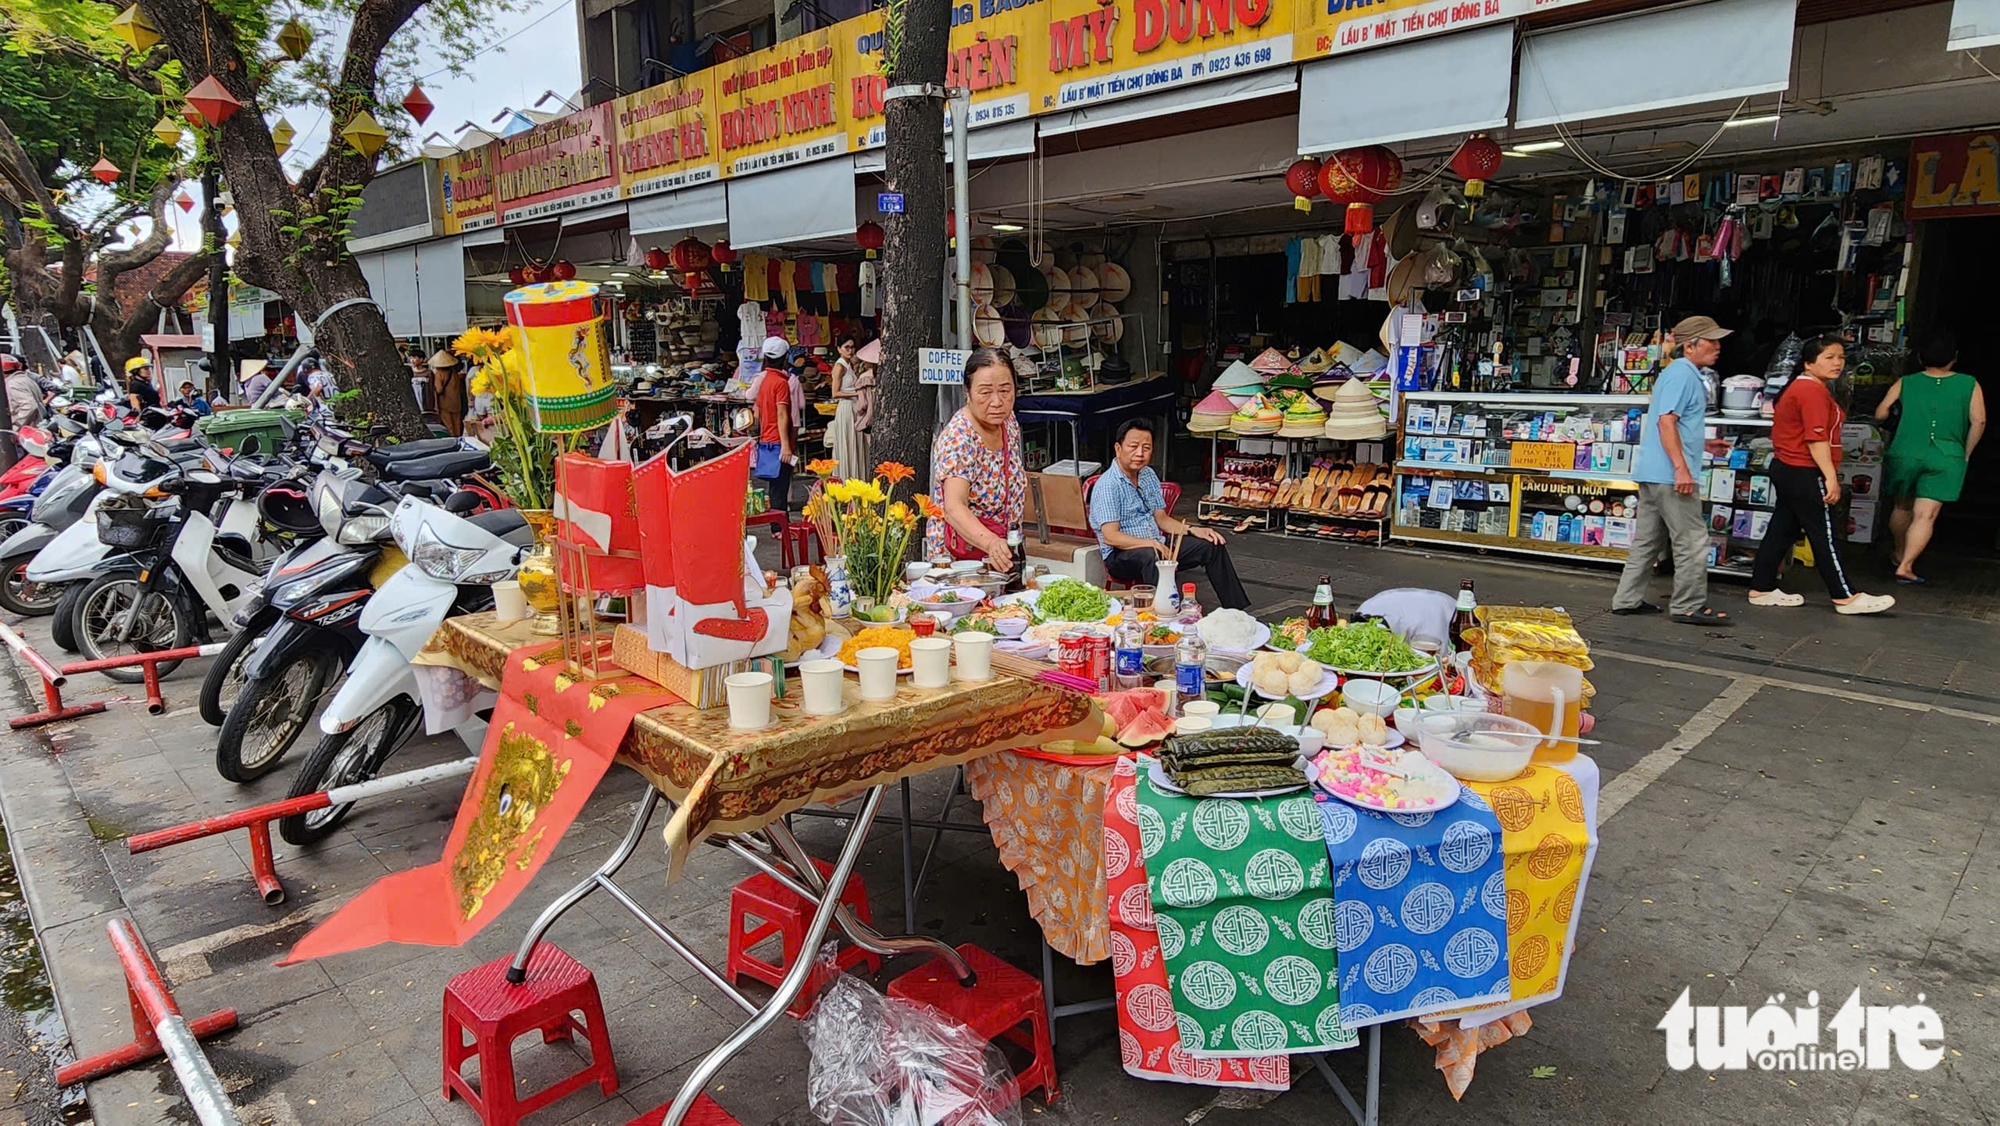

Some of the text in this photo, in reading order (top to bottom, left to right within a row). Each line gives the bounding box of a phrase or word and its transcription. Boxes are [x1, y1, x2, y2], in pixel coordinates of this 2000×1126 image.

[1484, 0, 1500, 16] BA
[1171, 66, 1183, 80] BA
[1208, 56, 1231, 73] 0923
[1234, 51, 1251, 67] 436
[1254, 47, 1272, 63] 698
[720, 82, 836, 151] HOÀNG NINH
[929, 351, 962, 366] COFFEE
[922, 368, 965, 382] COLD DRIN
